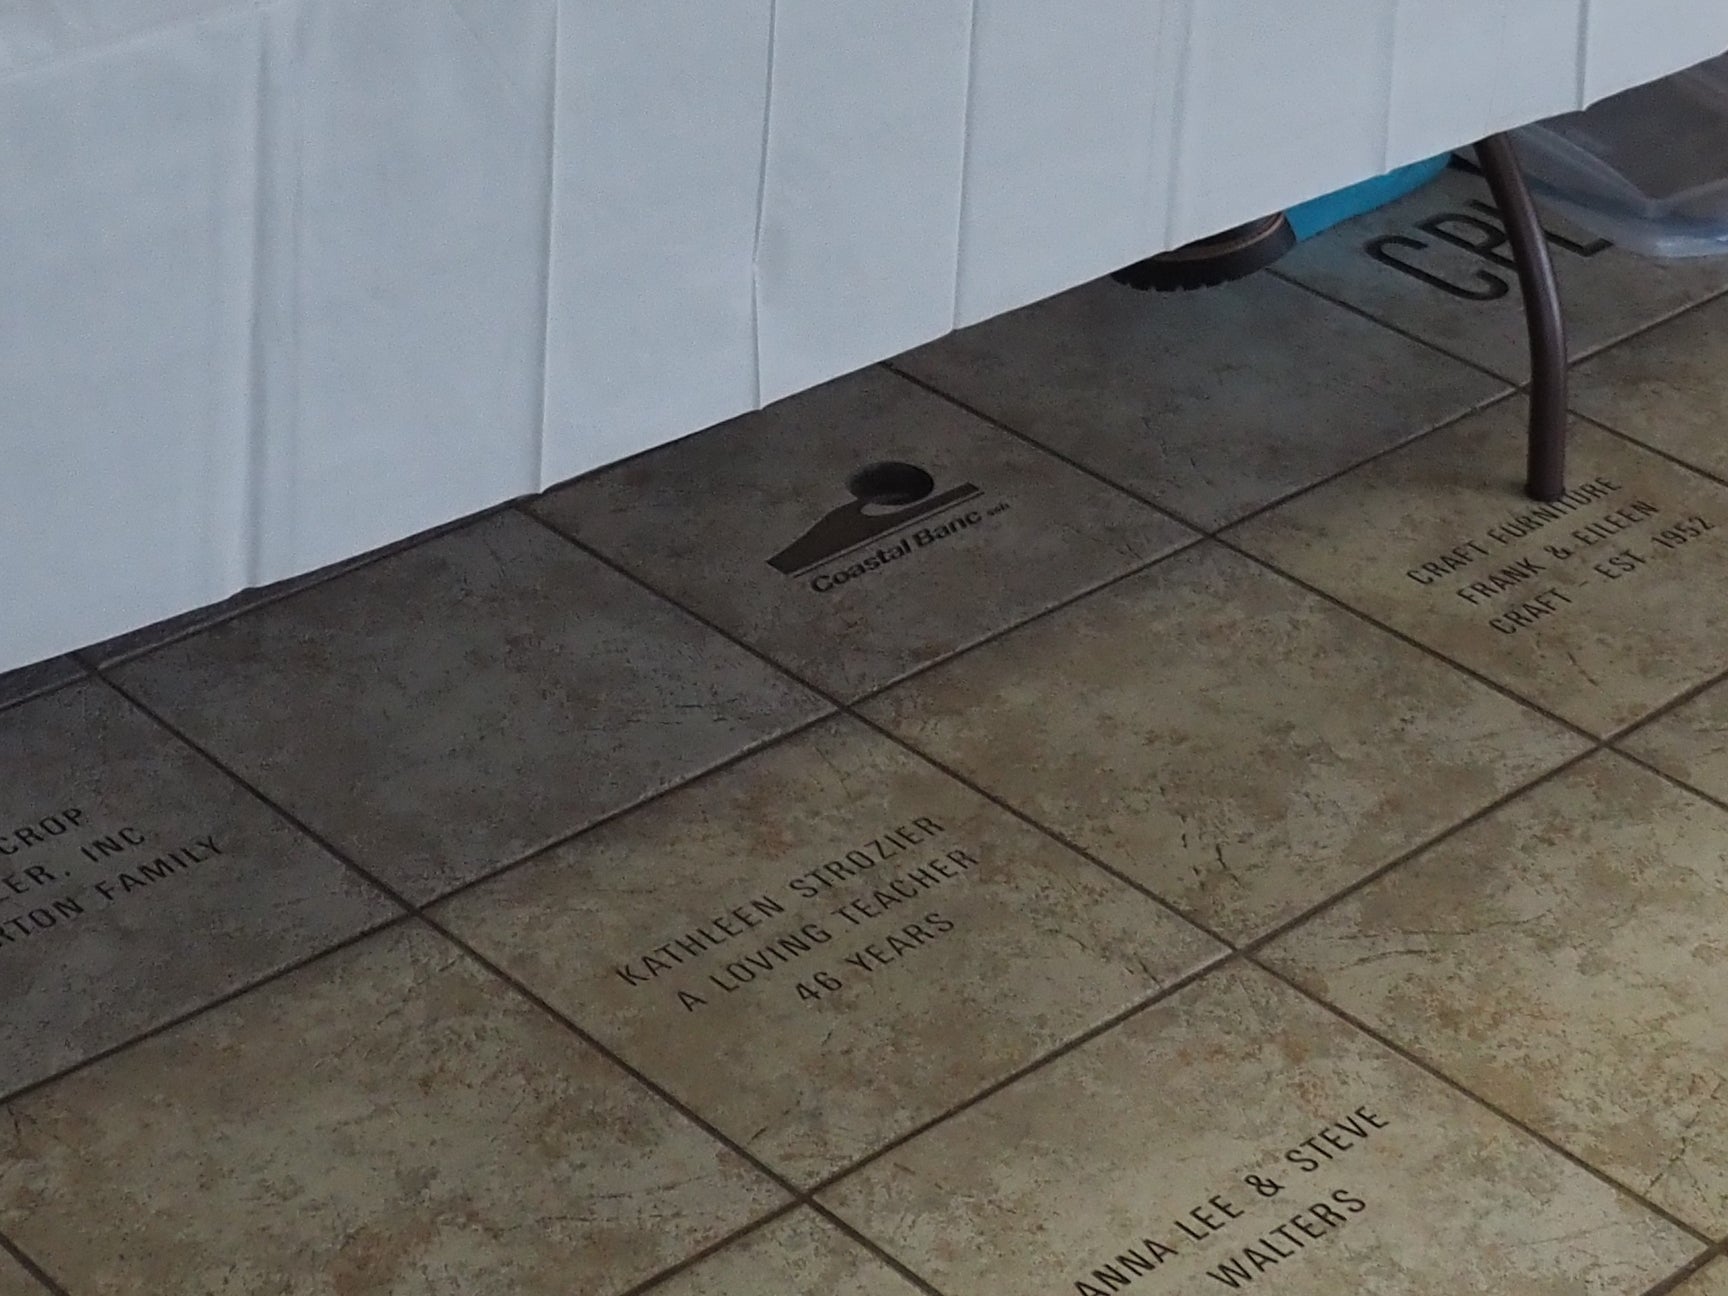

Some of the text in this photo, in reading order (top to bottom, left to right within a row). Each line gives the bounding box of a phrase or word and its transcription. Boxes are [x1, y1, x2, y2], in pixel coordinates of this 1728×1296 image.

[810, 538, 912, 592] Coastal
[912, 510, 983, 547] Banc
[1406, 475, 1622, 586] CRAFT FURNITURE
[1456, 499, 1660, 605] FRANK & EILEEN
[1488, 587, 1573, 635] CRAFT
[1594, 548, 1647, 580] EST
[1650, 514, 1716, 549] 1952
[81, 826, 145, 862] INC
[95, 835, 224, 901] FAMILY
[615, 816, 946, 987] KATHLEEN STROZIER
[676, 848, 980, 1012] A LOVING TEACHER
[795, 912, 954, 1001] 46 YEARS
[1073, 1105, 1390, 1296] ANNA LEE & STEVE
[1206, 1189, 1366, 1290] WALTERS
